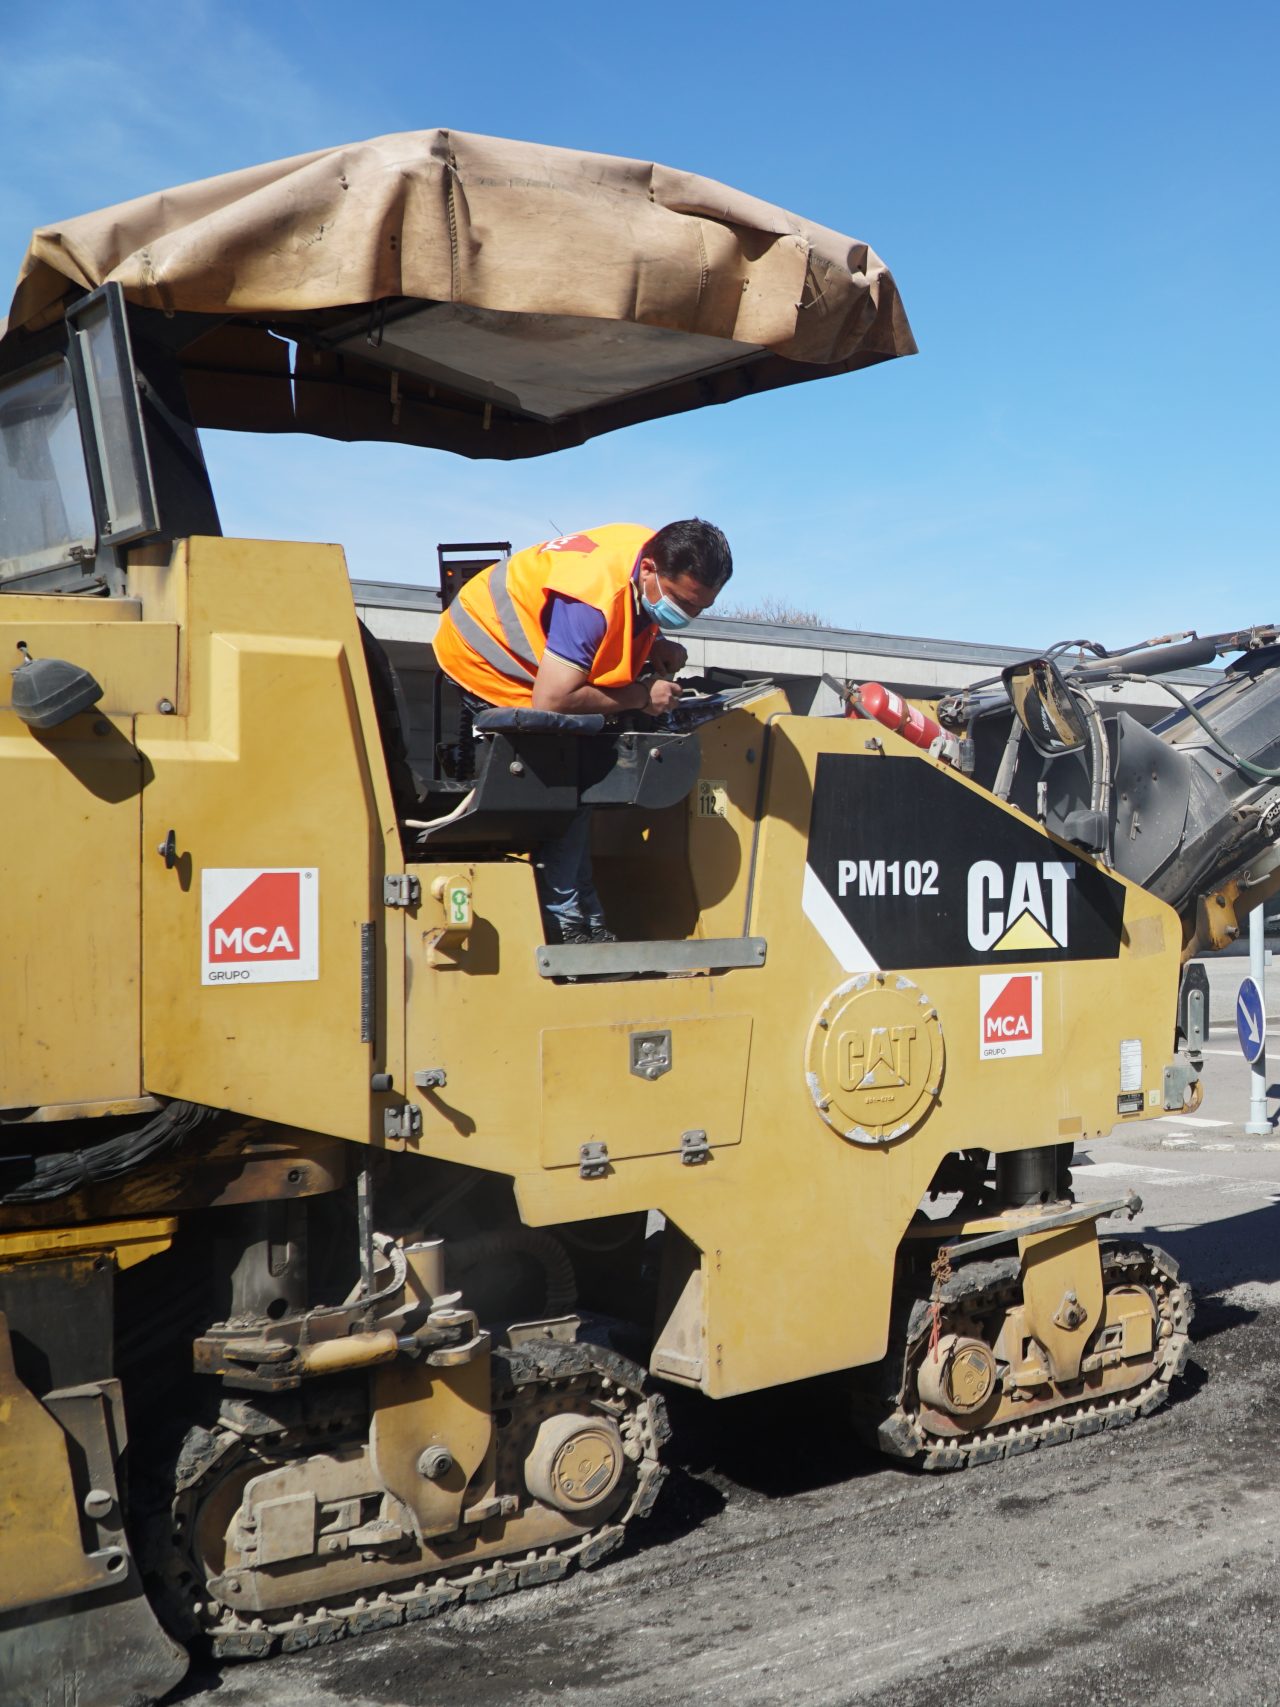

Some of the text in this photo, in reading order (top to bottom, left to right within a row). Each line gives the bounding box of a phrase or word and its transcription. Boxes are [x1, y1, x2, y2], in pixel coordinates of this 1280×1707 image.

[700, 796, 717, 815] 112
[838, 860, 939, 896] PM102
[967, 860, 1076, 951] CAT
[214, 926, 294, 955] MCA
[208, 970, 250, 981] GRUPO
[987, 1015, 1029, 1037] MCA
[838, 1025, 916, 1092] CAT
[984, 1048, 1006, 1056] GRUPO
